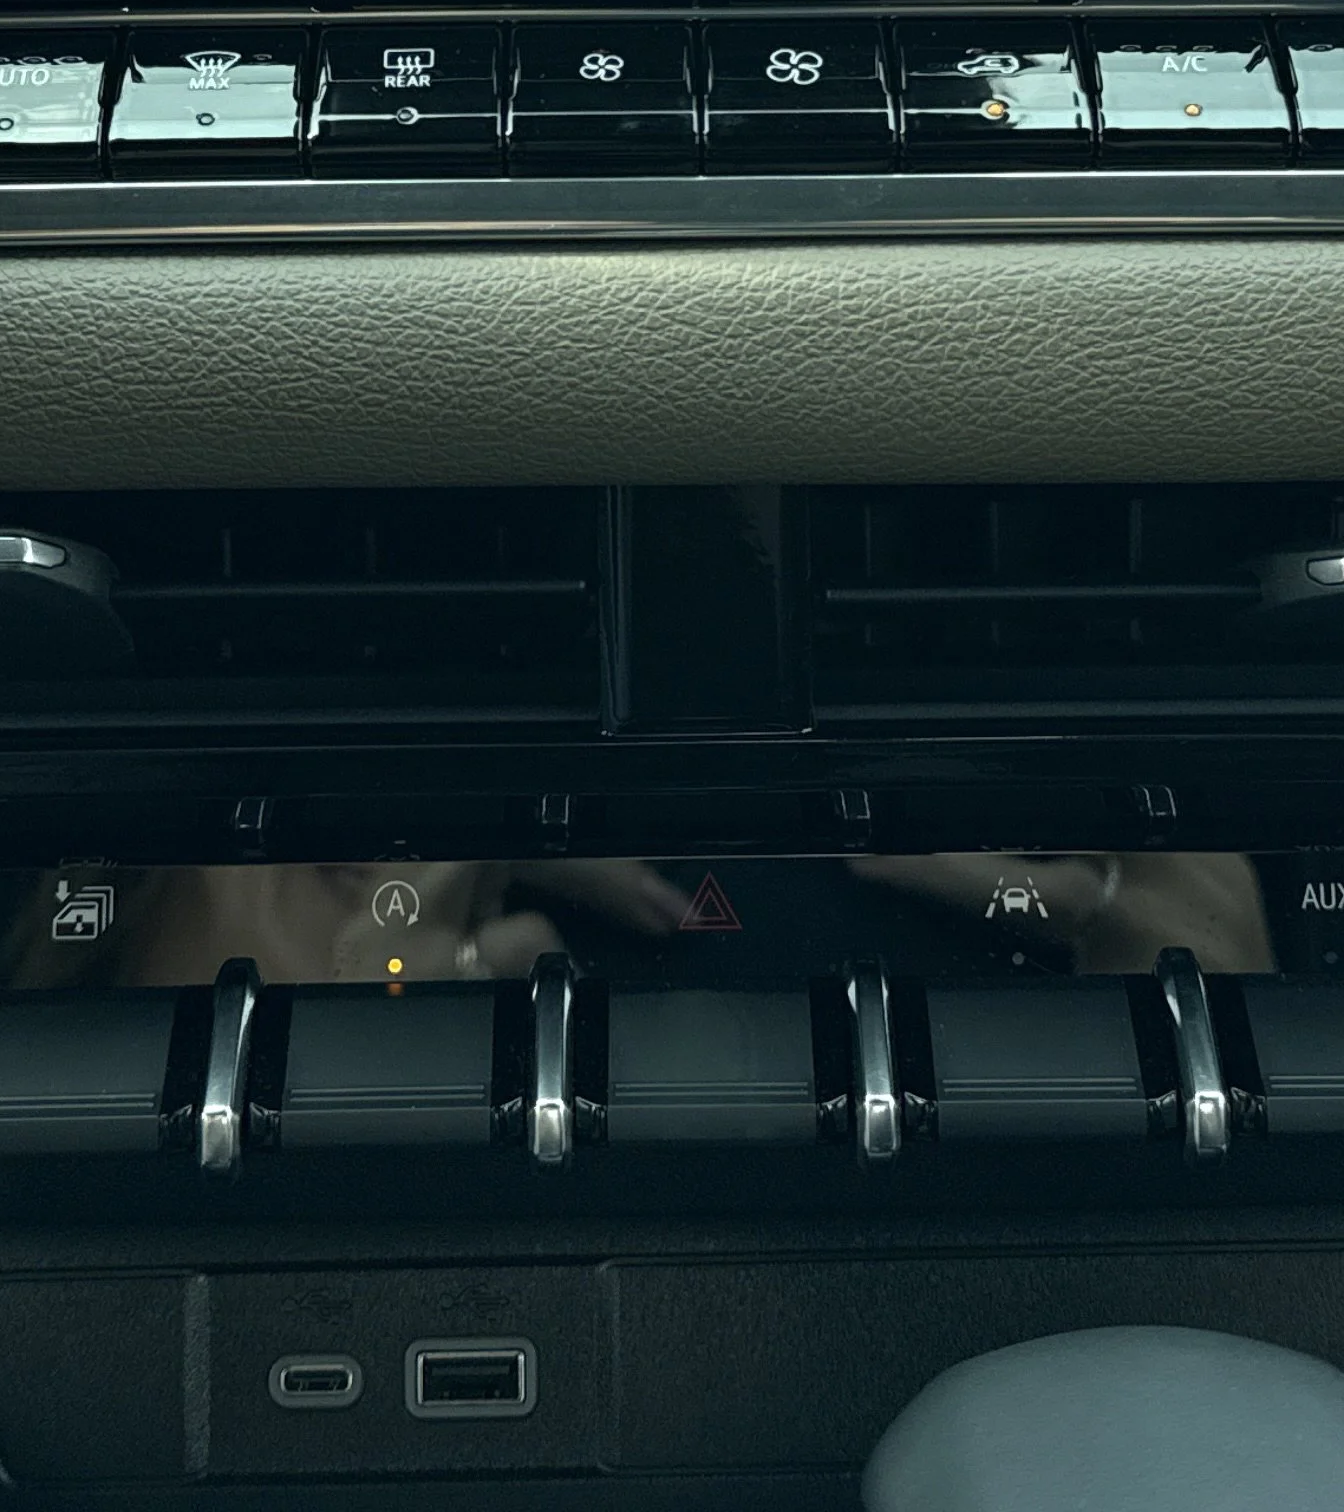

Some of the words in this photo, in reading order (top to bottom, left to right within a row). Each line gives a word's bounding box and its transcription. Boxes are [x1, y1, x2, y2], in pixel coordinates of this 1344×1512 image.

[1161, 54, 1209, 74] A/C
[188, 74, 231, 90] MAX
[384, 73, 432, 88] REAR
